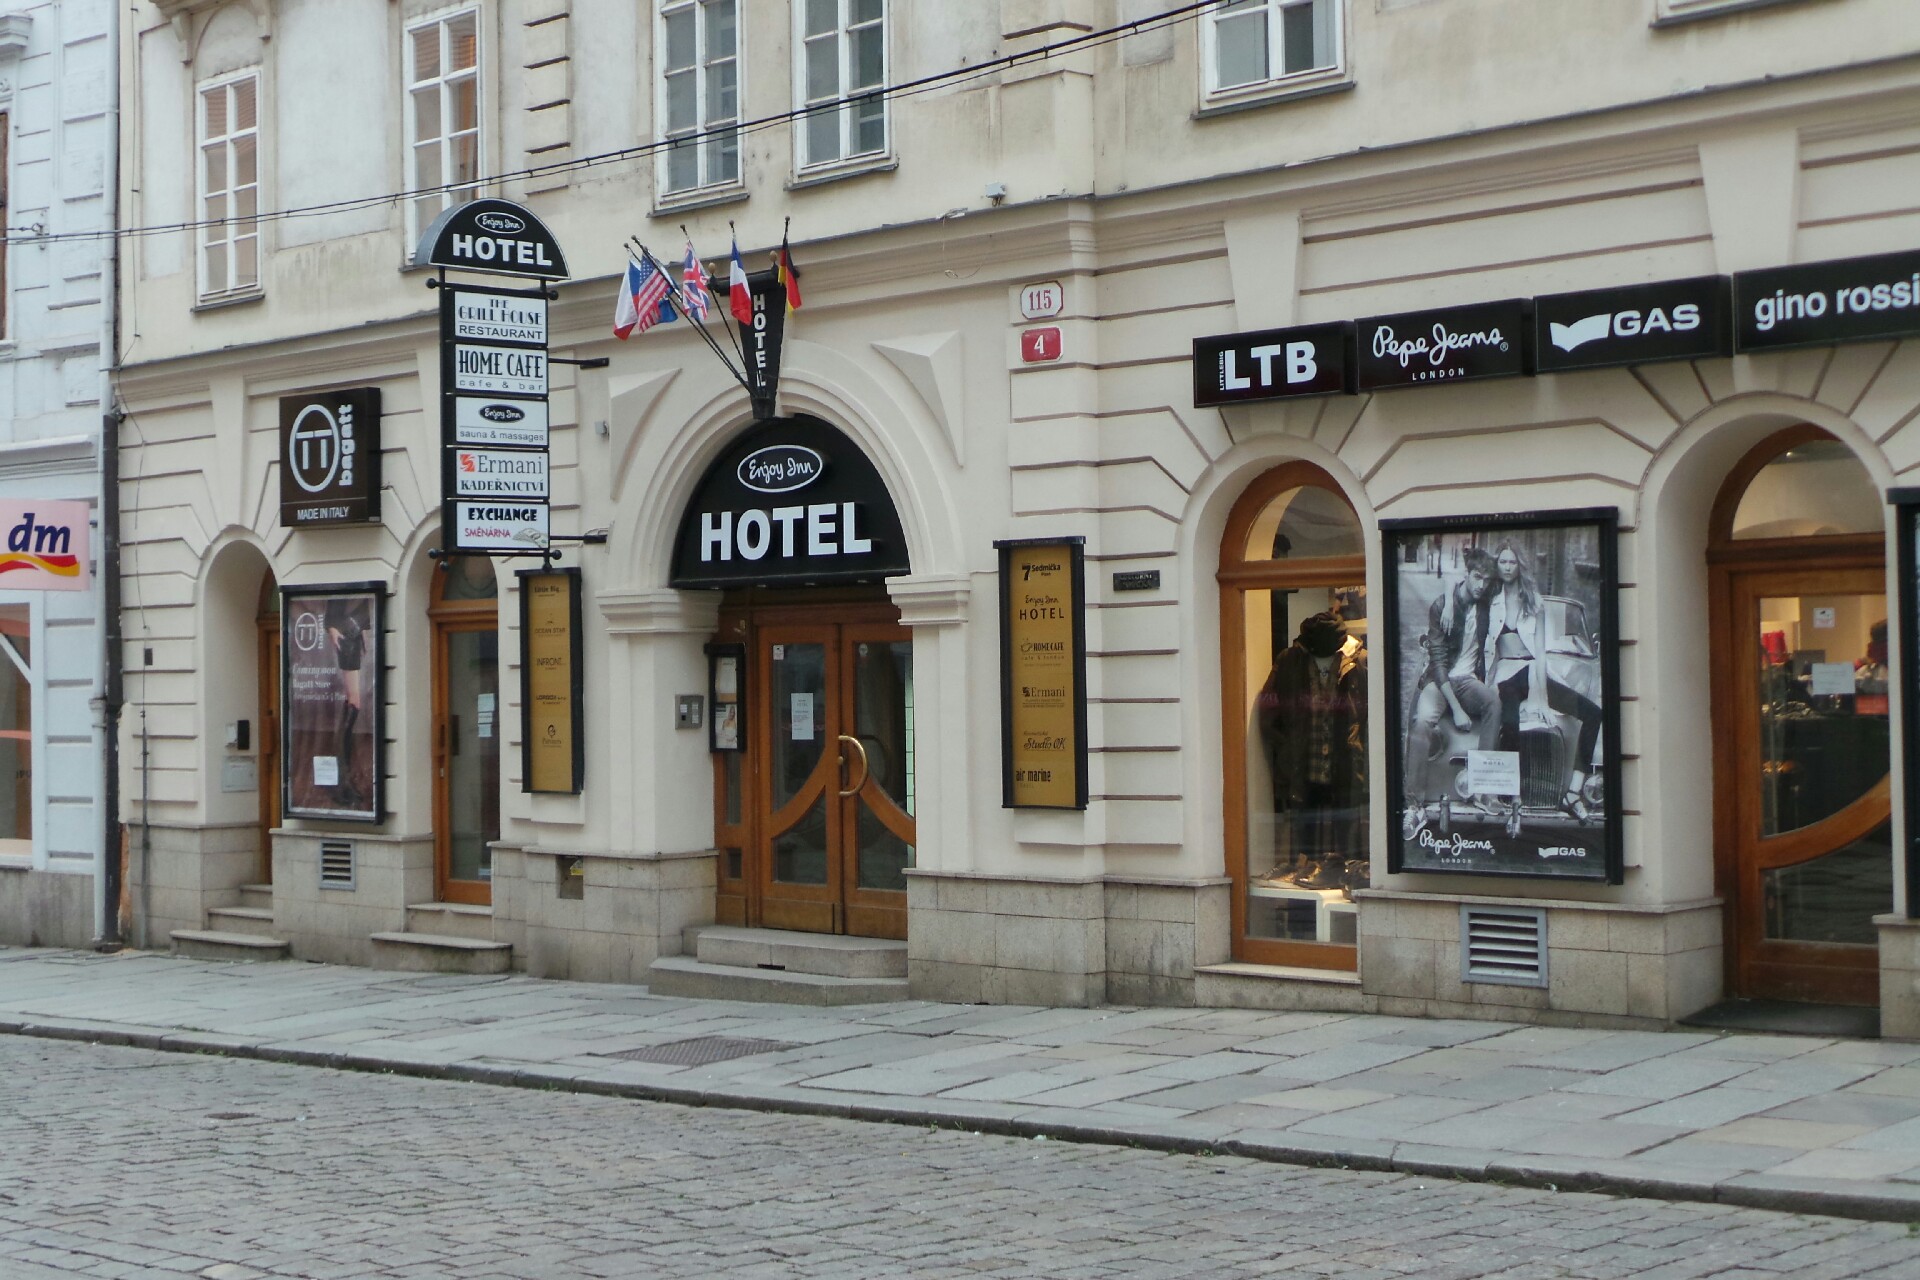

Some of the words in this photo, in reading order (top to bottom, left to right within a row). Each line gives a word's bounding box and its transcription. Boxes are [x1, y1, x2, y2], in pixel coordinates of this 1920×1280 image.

[482, 214, 504, 229] Enjoy
[504, 218, 520, 229] Inn
[452, 233, 553, 267] HOTEL
[490, 298, 509, 309] THE
[1029, 289, 1052, 311] 115
[1755, 289, 1827, 331] gino
[1837, 273, 1920, 315] rossi
[458, 305, 497, 322] GRILL
[501, 309, 543, 326] HOUSE
[1613, 303, 1701, 338] GAS
[459, 324, 543, 340] RESTAURANT
[753, 294, 767, 388] HOTEL
[1033, 334, 1045, 355] 4
[1372, 325, 1429, 368] Pepe
[1428, 322, 1503, 366] Jeans
[458, 349, 503, 376] HOME
[506, 353, 544, 379] CAFE
[1224, 340, 1318, 391] LTB
[1411, 367, 1465, 381] LONDON
[459, 379, 492, 388] cafe
[502, 380, 509, 389] &
[519, 382, 543, 391] bar
[484, 408, 506, 420] Enjoy
[506, 410, 521, 419] Inn
[460, 430, 488, 439] sauna
[489, 431, 497, 439] &
[499, 432, 544, 443] massages
[477, 454, 544, 475] Ermani
[749, 458, 784, 484] Enjoy
[786, 457, 814, 475] Inn
[460, 478, 544, 492] KADEŘNICTVÍ
[297, 508, 319, 520] MADE
[320, 508, 326, 520] IN
[328, 506, 350, 518] ITALY
[468, 507, 538, 522] EXCHANGE
[8, 512, 71, 554] dm
[464, 526, 512, 538] SMĚNÁRNA
[701, 502, 872, 562] HOTEL
[1020, 608, 1064, 620] HOTEL
[1033, 642, 1050, 652] HOME
[1031, 686, 1065, 698] Ermani
[1016, 768, 1026, 782] air
[1419, 828, 1452, 855] Pepe
[1451, 832, 1492, 856] Jeans
[1559, 847, 1586, 858] GAS
